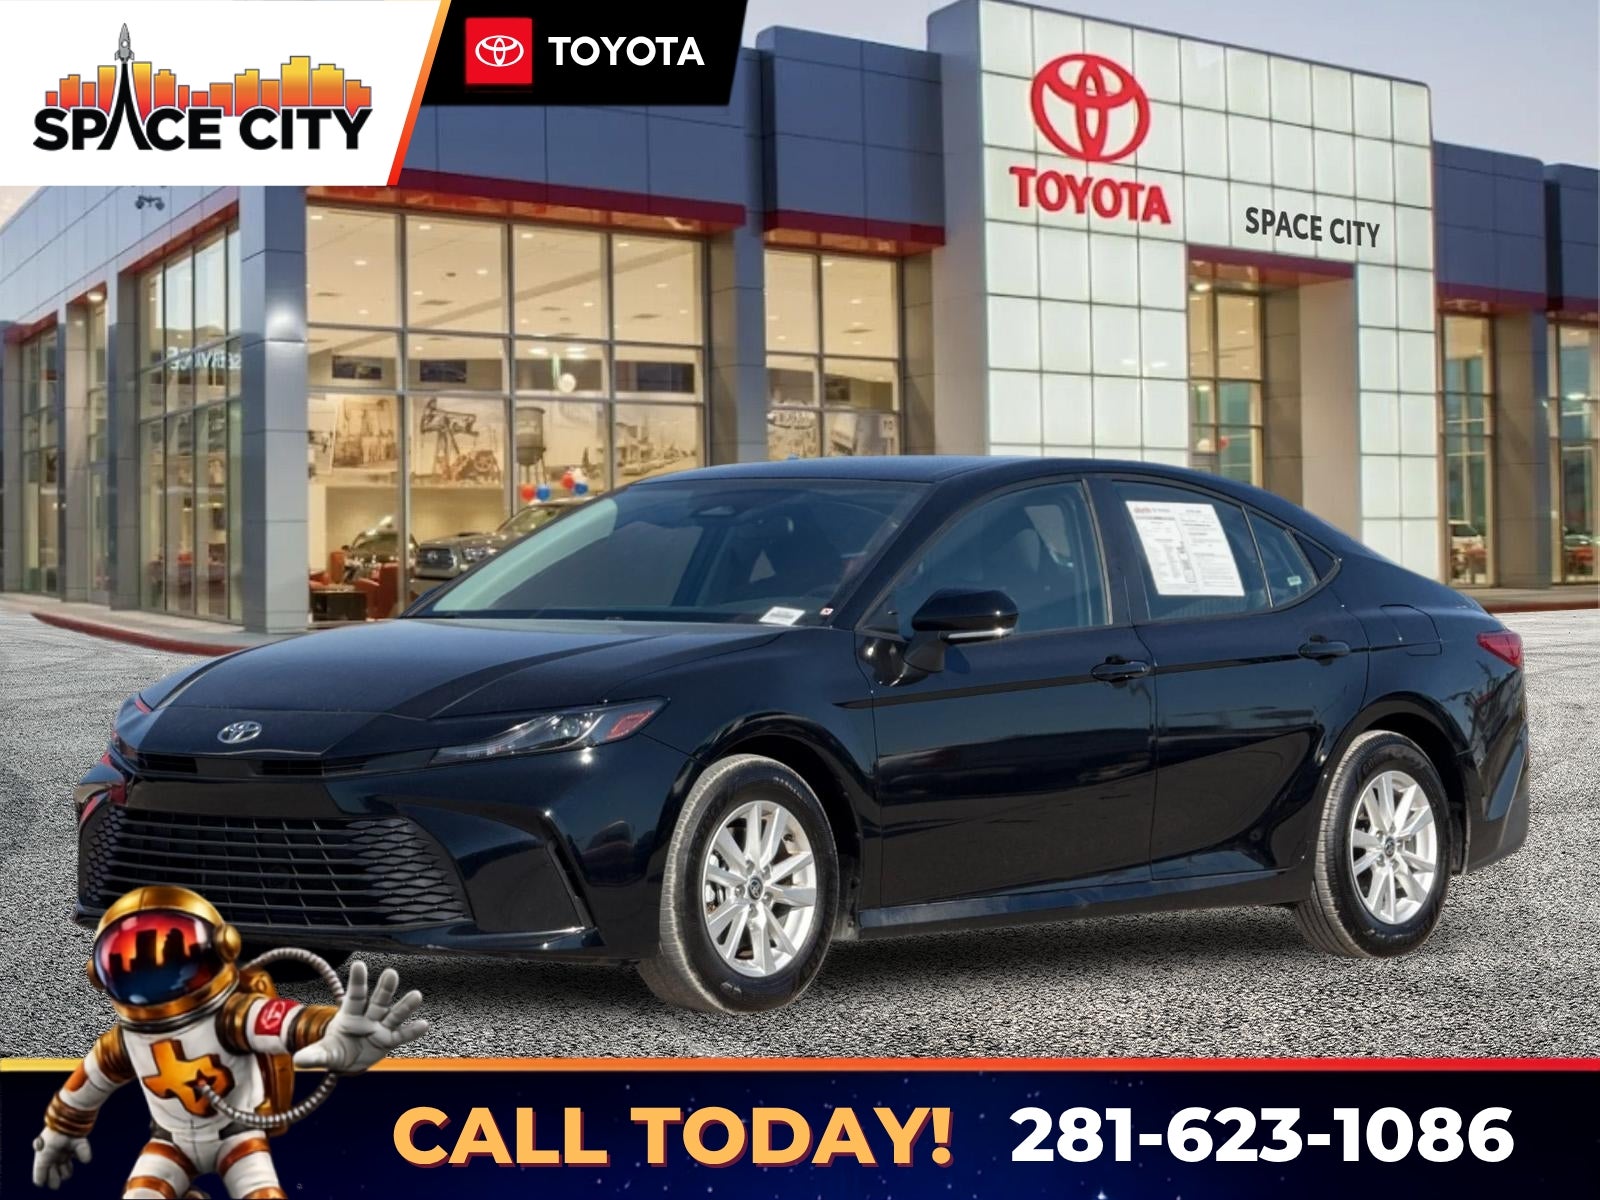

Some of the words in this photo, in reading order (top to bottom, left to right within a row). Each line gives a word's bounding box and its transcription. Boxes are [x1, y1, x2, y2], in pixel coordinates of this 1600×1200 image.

[1008, 166, 1171, 224] TOYOTA
[1245, 206, 1323, 242] SPACE
[1329, 218, 1381, 249] CITY
